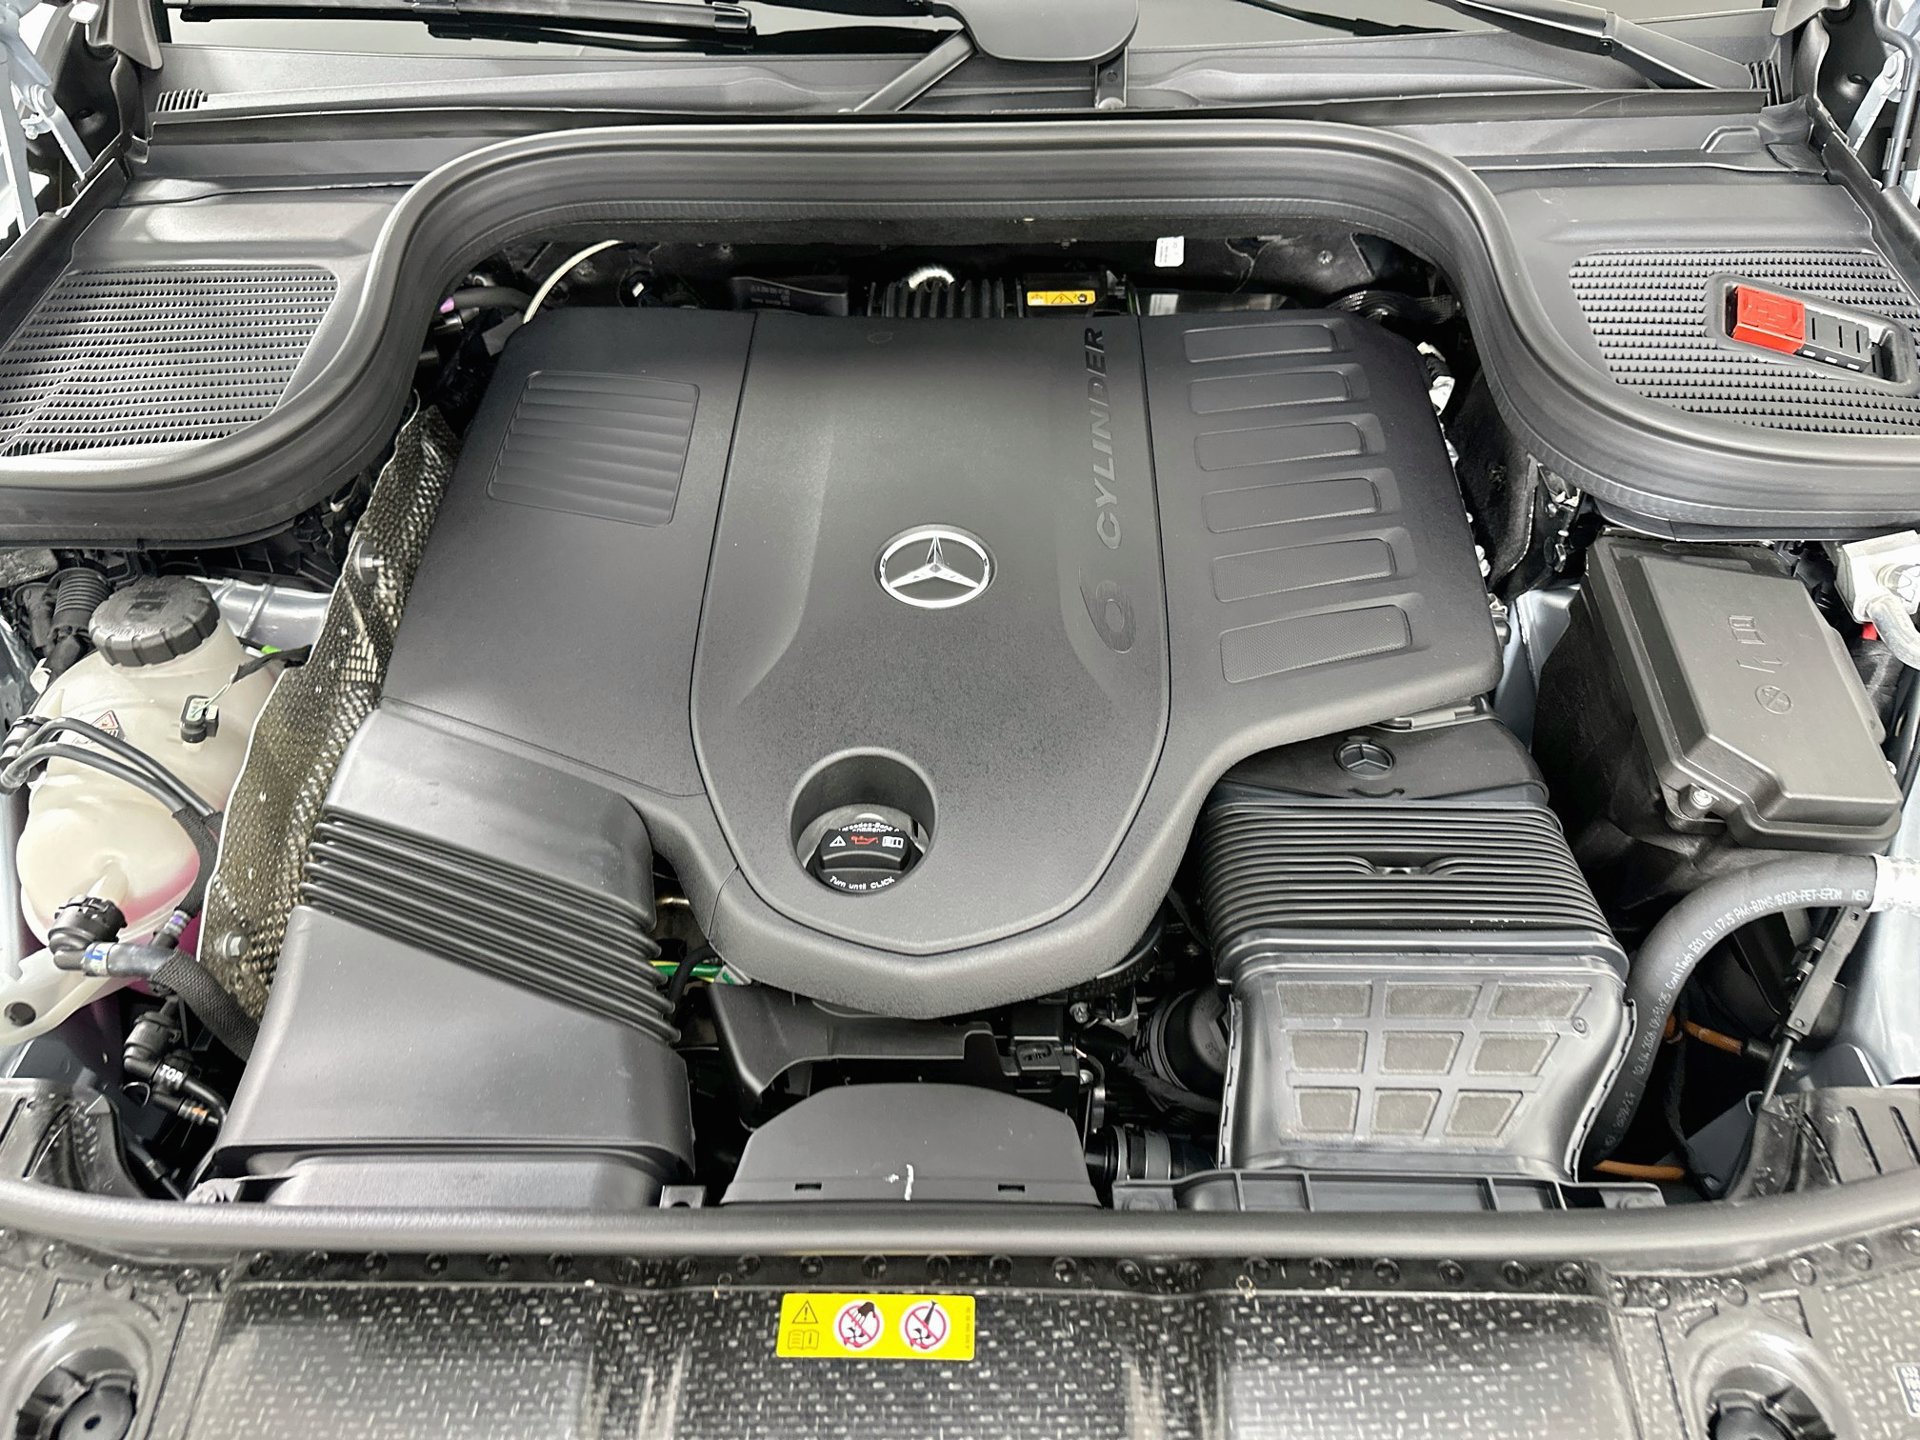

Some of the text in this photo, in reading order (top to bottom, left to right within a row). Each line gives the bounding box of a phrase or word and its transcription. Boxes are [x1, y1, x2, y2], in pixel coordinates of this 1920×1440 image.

[1084, 327, 1122, 550] CYLINDER
[830, 875, 847, 888] Turn
[870, 875, 895, 889] CLICK
[160, 1063, 184, 1082] TOP
